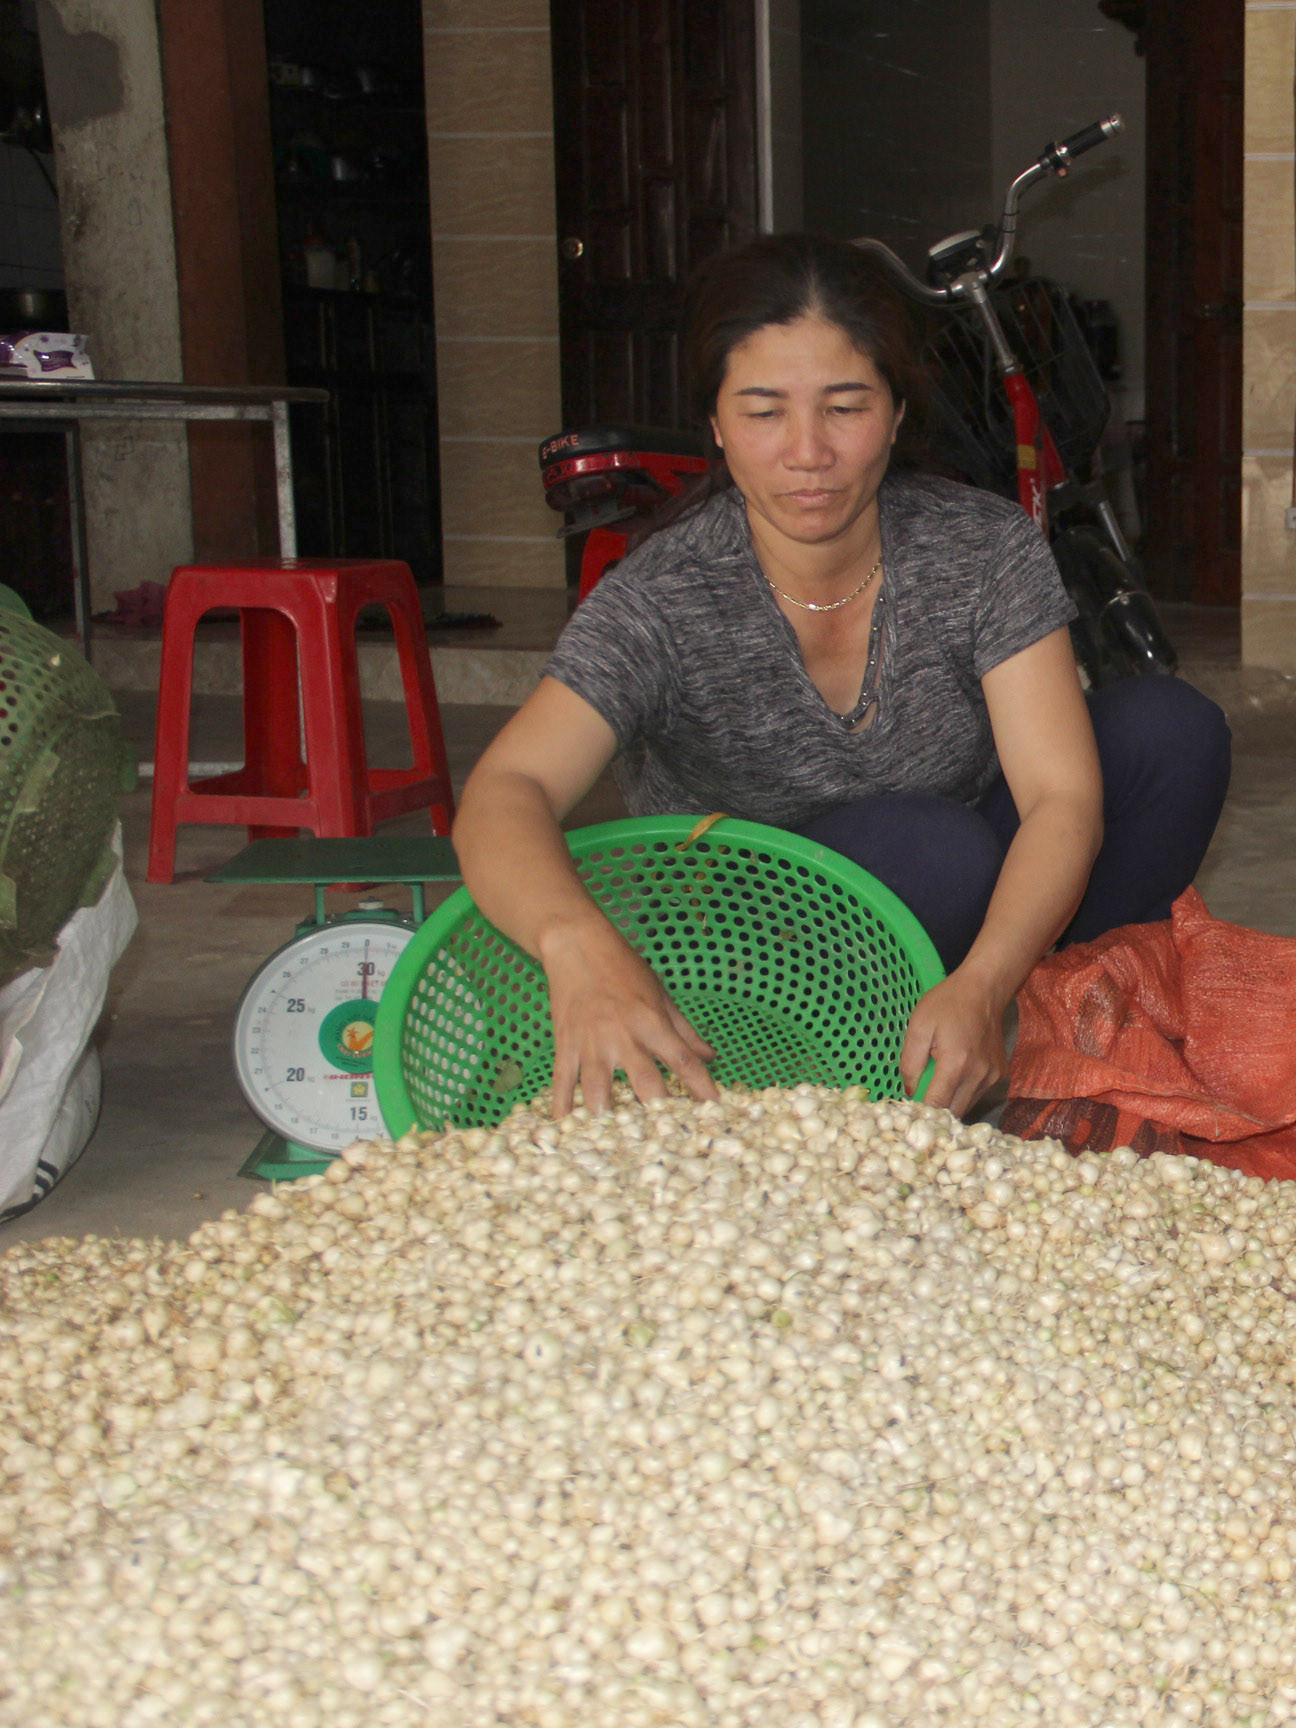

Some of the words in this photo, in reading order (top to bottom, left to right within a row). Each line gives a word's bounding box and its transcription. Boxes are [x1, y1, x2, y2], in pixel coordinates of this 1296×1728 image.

[542, 434, 580, 459] E-BIKE
[357, 961, 375, 976] 30
[286, 998, 305, 1013] 25
[286, 1067, 305, 1082] 20
[350, 1106, 368, 1121] 15
